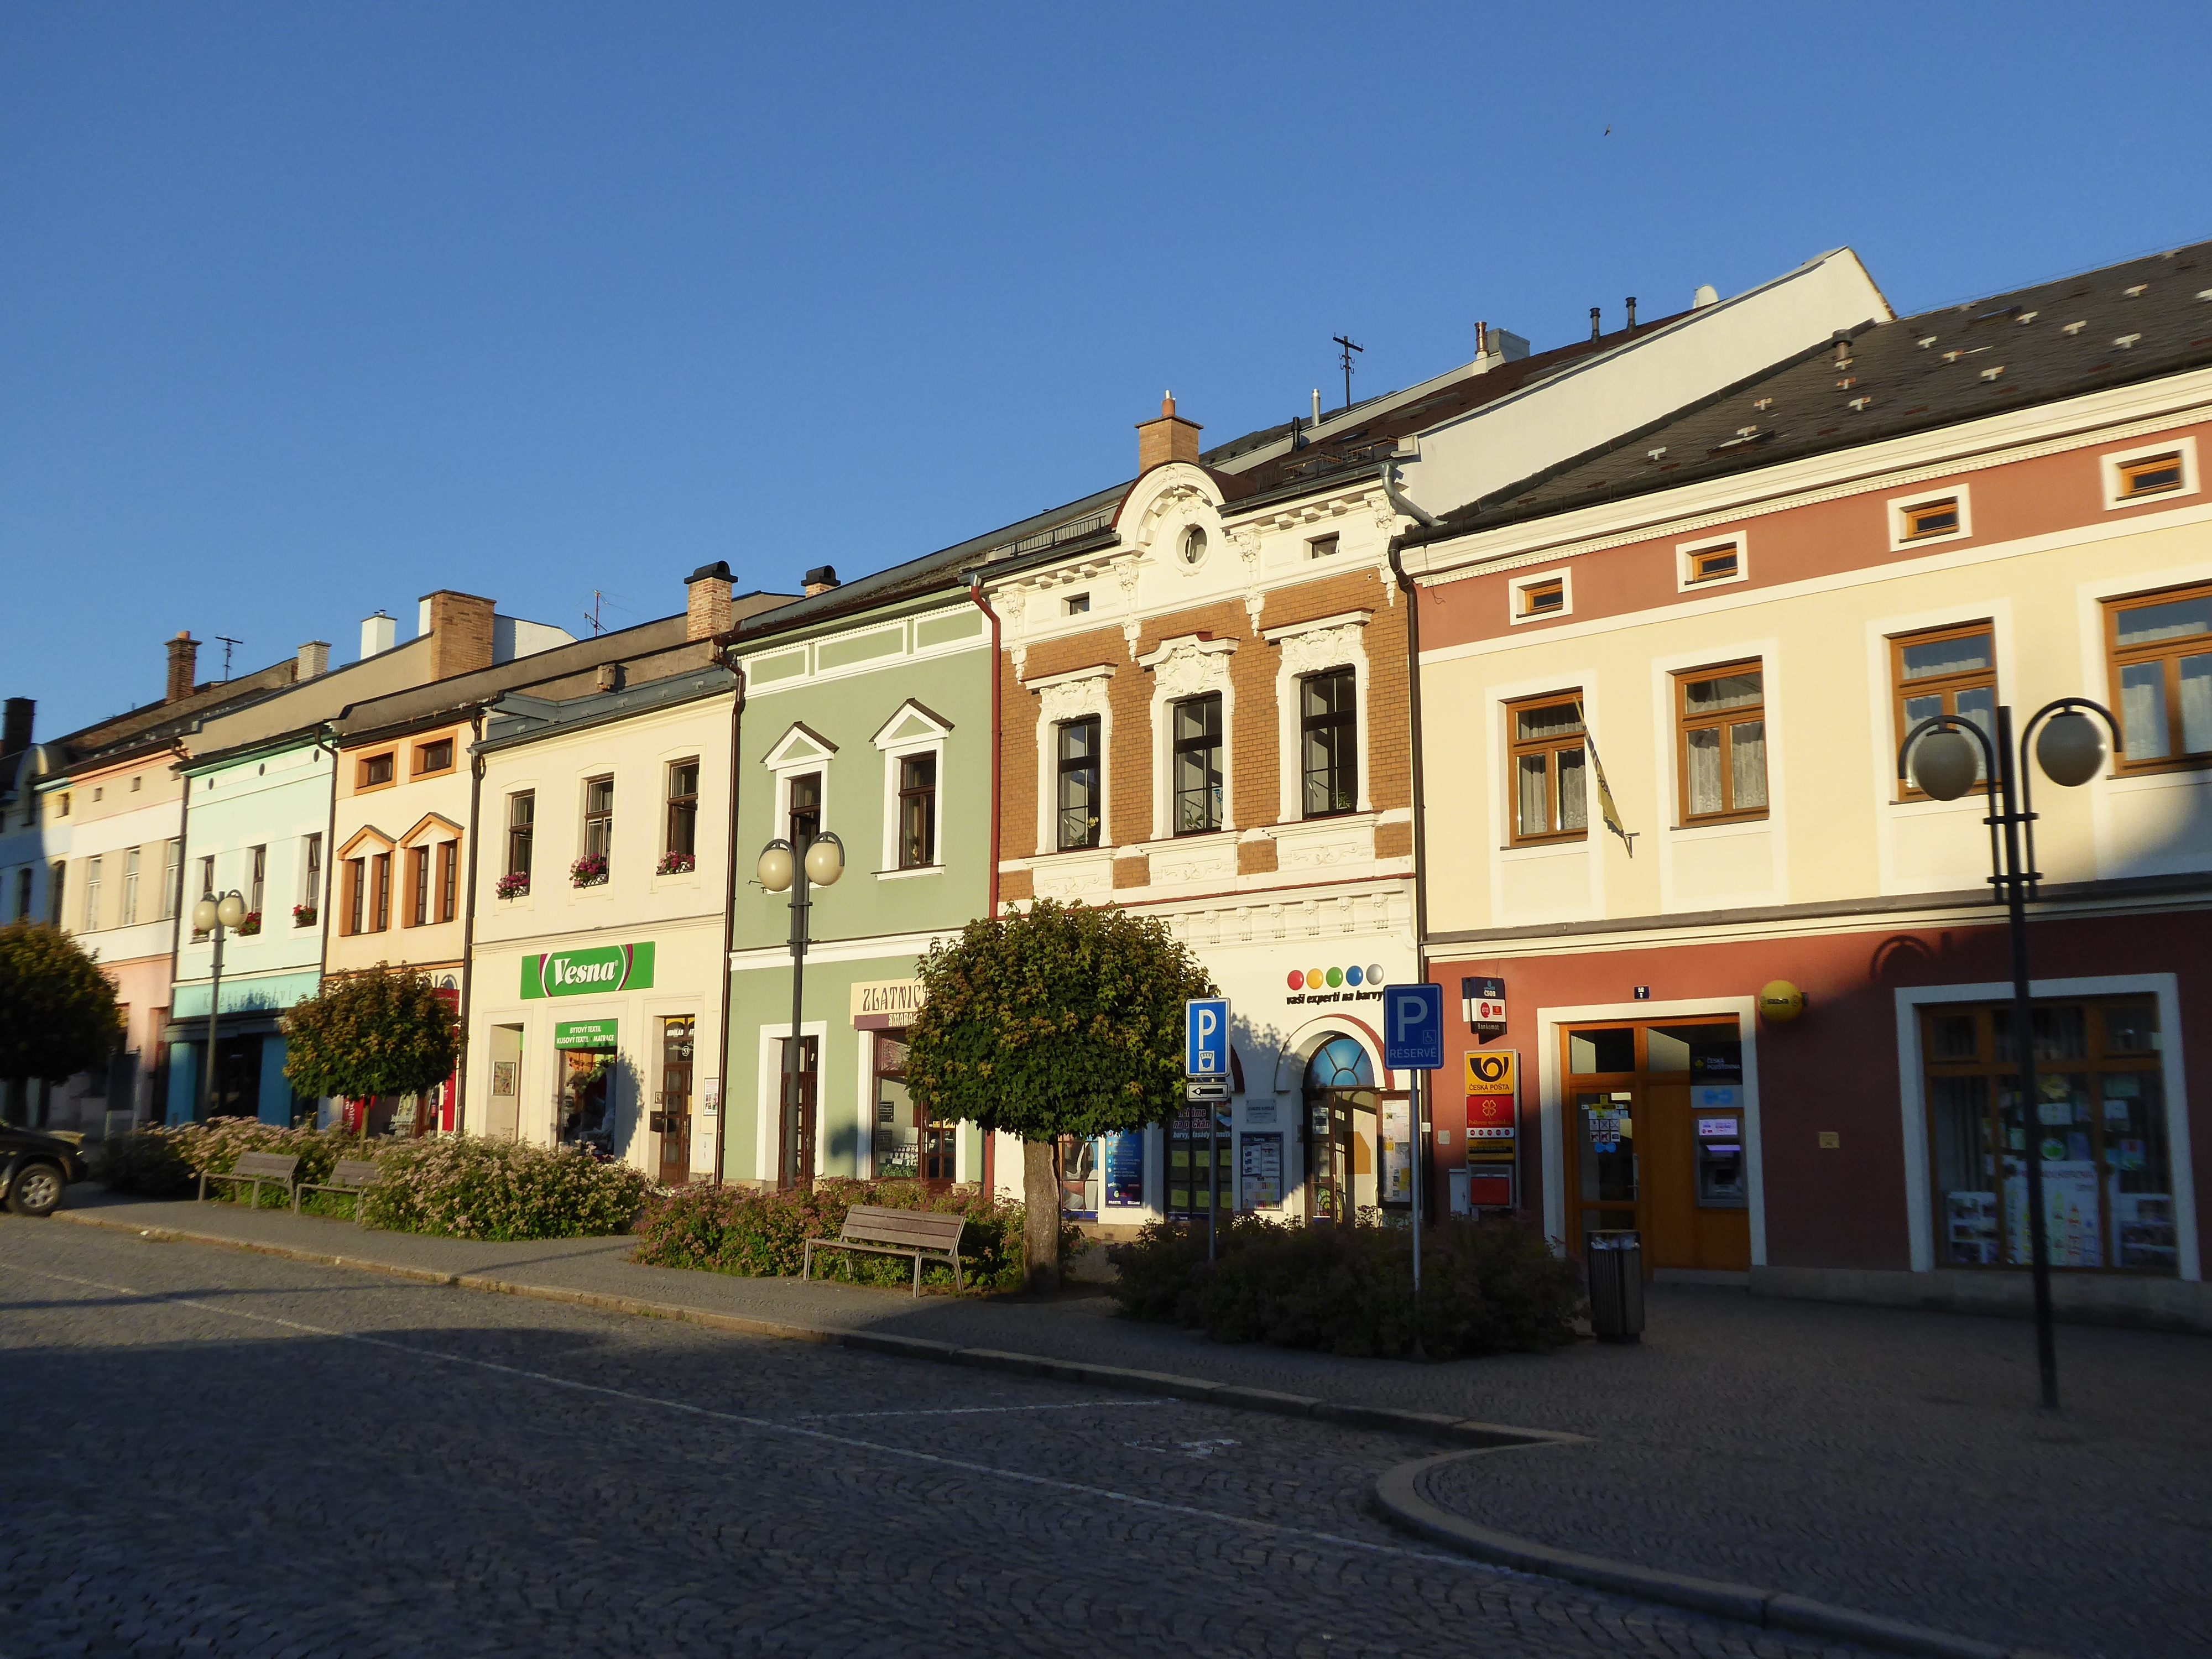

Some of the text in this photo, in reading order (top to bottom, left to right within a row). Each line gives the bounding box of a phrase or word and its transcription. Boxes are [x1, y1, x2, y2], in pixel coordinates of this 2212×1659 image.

[554, 958, 615, 986] Vesna
[1286, 990, 1384, 1005] vaši experti na barvy
[1397, 996, 1428, 1042] P
[570, 1025, 587, 1034] BYTOVÝ
[1199, 1009, 1217, 1050] P
[557, 1035, 575, 1044] KUSOVÝ
[1390, 1046, 1437, 1058] RÉSERVÉ
[1490, 1082, 1509, 1091] POŠTA
[1173, 1120, 1183, 1129] na
